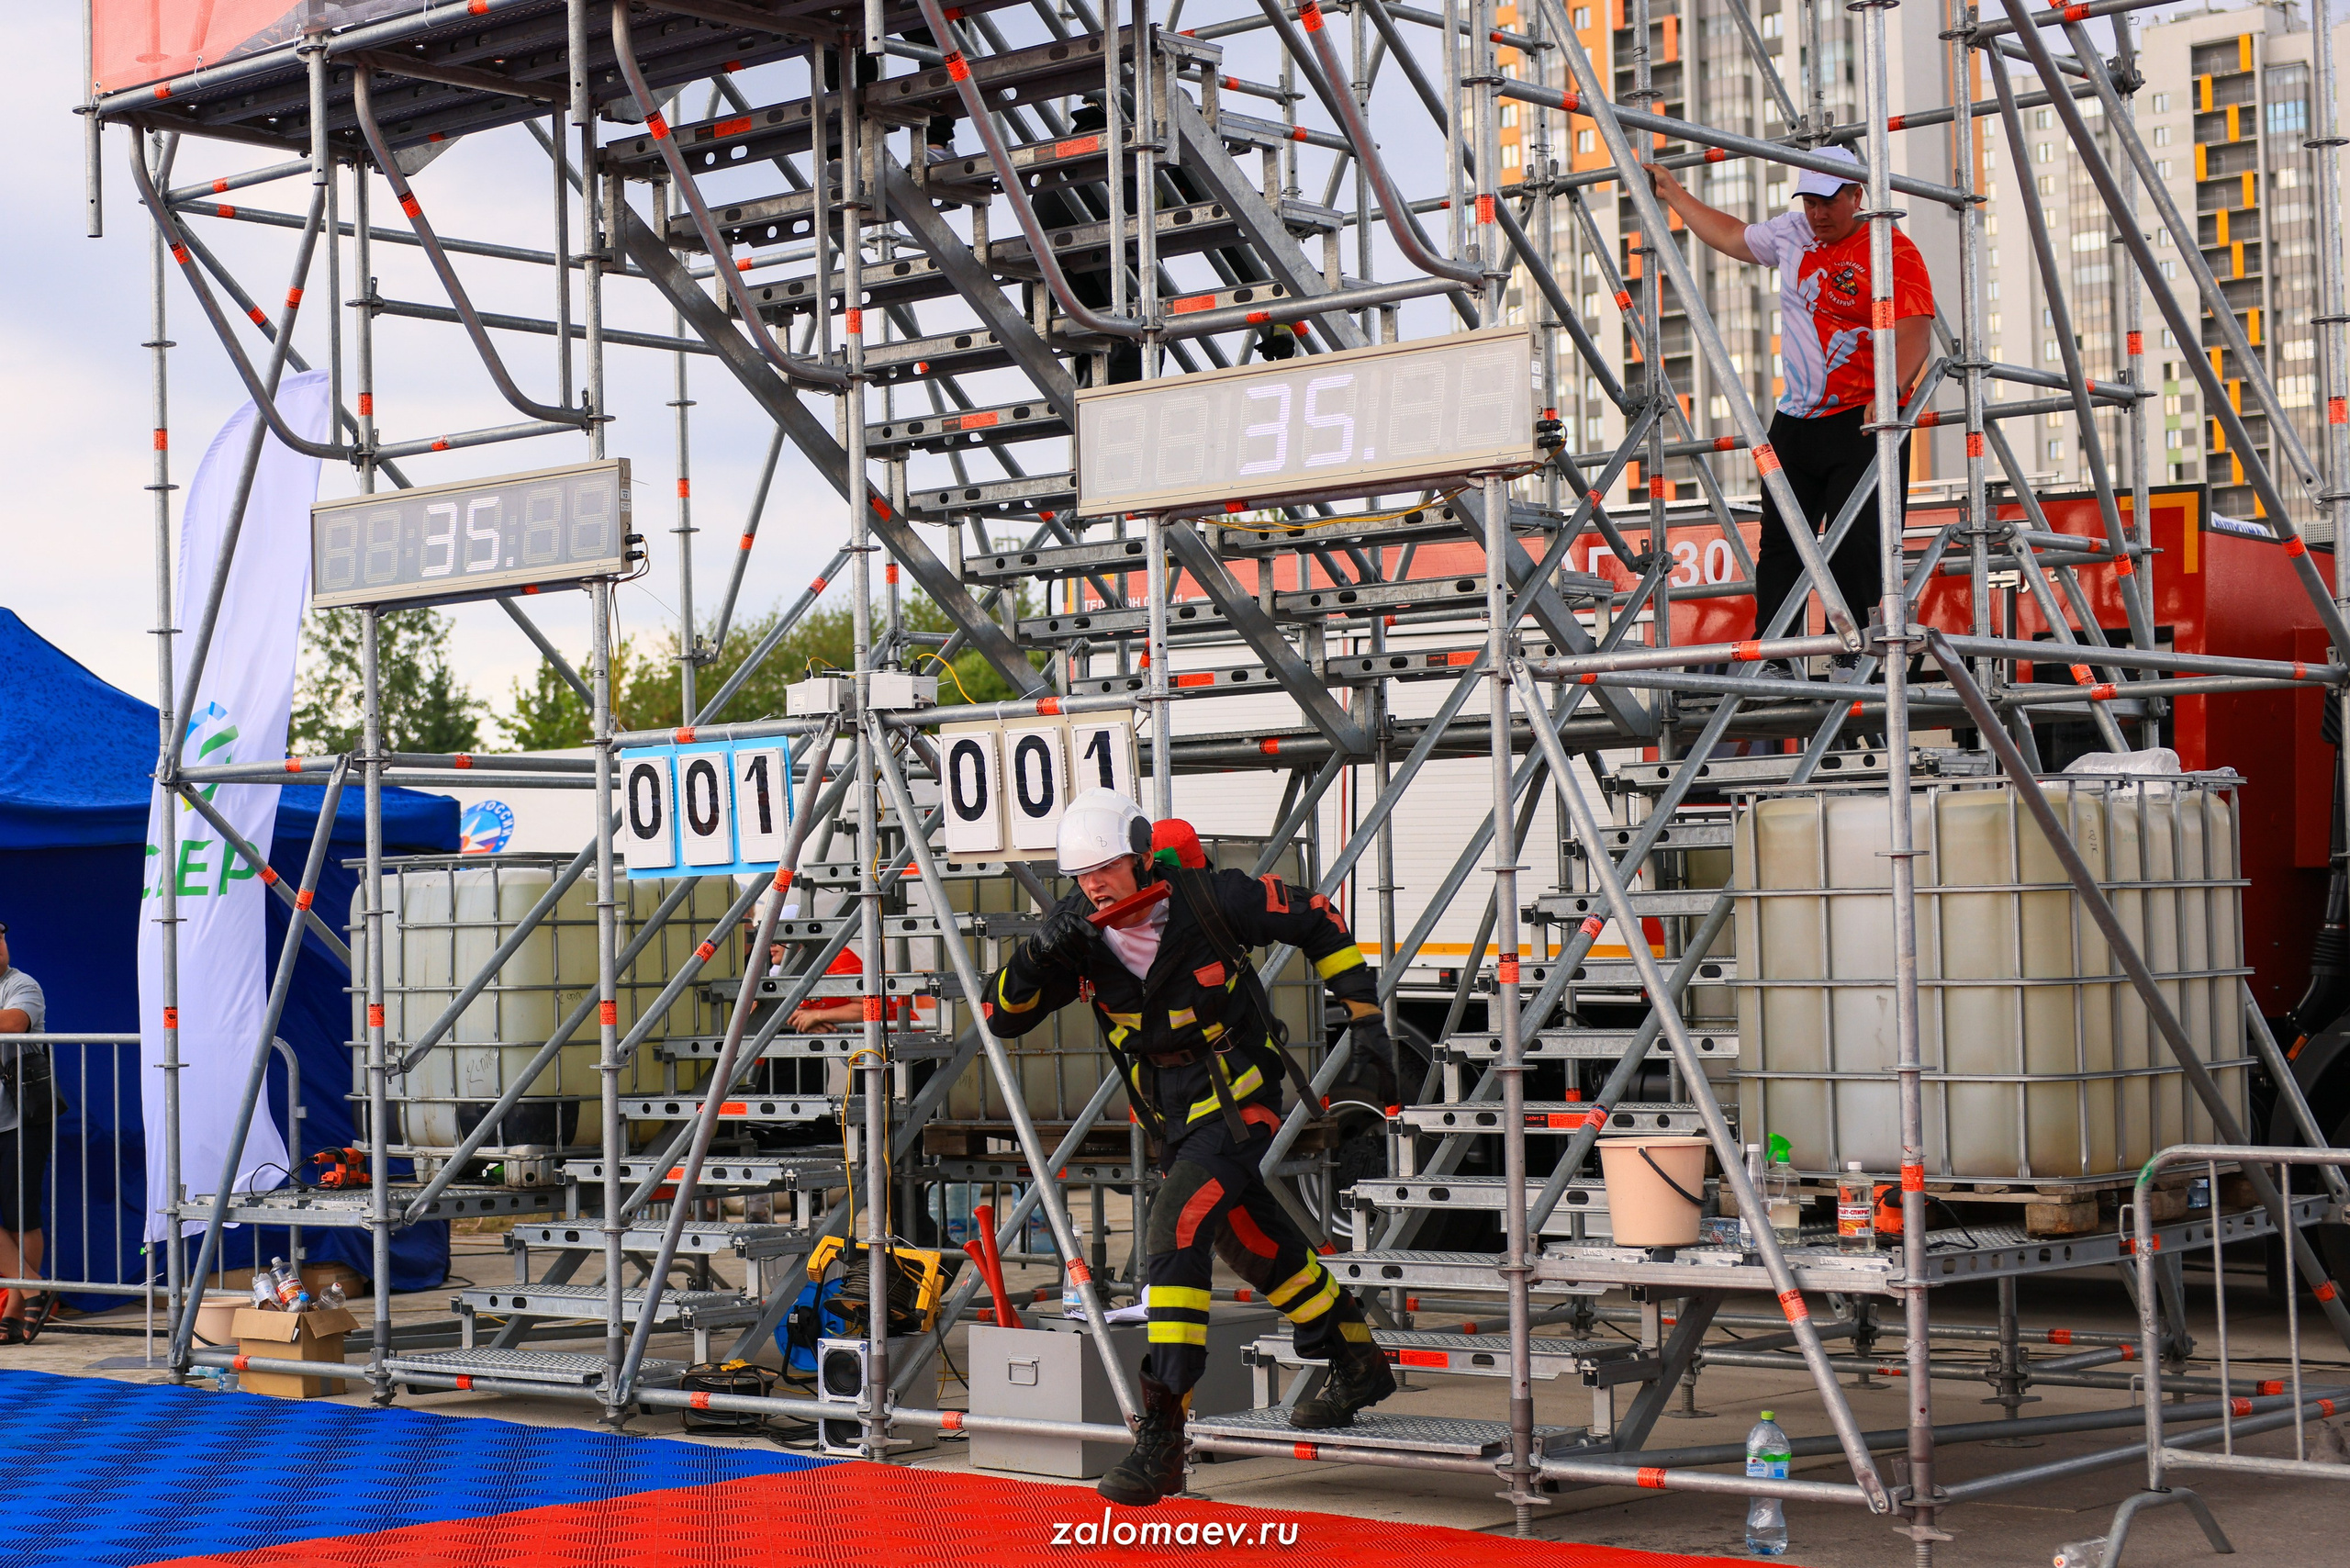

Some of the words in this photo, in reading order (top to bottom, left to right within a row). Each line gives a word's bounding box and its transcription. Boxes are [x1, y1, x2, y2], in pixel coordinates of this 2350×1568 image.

[1827, 290, 1857, 308] ПОЖАРНЫЙ
[628, 755, 773, 840] 001
[948, 730, 1115, 822] 001
[476, 801, 514, 838] РОССИИ
